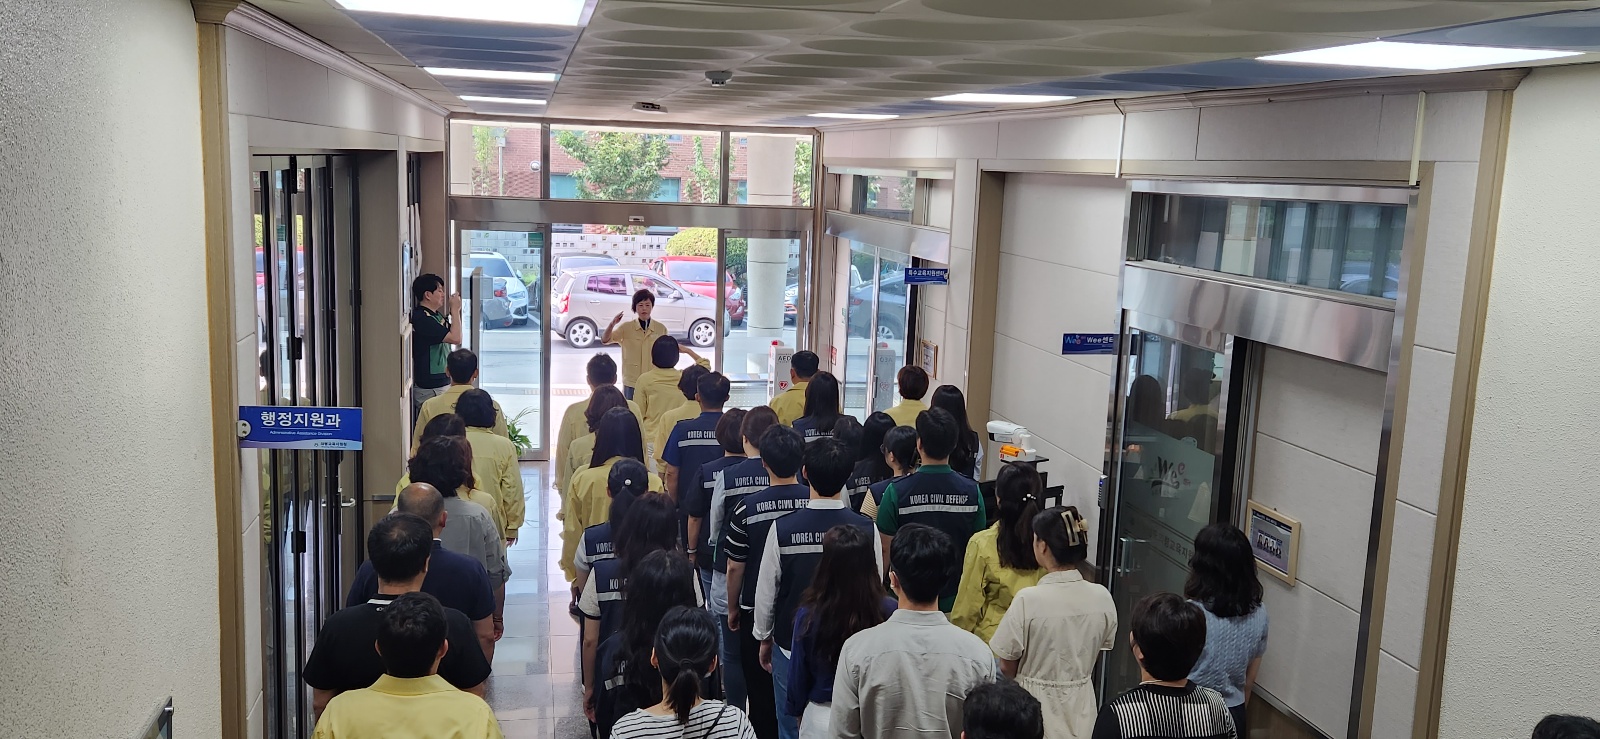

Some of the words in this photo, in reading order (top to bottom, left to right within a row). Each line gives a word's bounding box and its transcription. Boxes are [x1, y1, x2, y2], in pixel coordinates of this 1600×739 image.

[261, 411, 341, 427] 행정지원과
[687, 430, 702, 439] KOREA
[734, 477, 754, 487] KOREA
[755, 476, 770, 486] CIVIL
[756, 502, 777, 512] KOREA
[778, 500, 794, 510] CIVIL
[795, 498, 809, 508] DEFE
[910, 494, 929, 505] KOREA
[930, 494, 945, 503] CIVIL
[791, 533, 814, 544] KOREA
